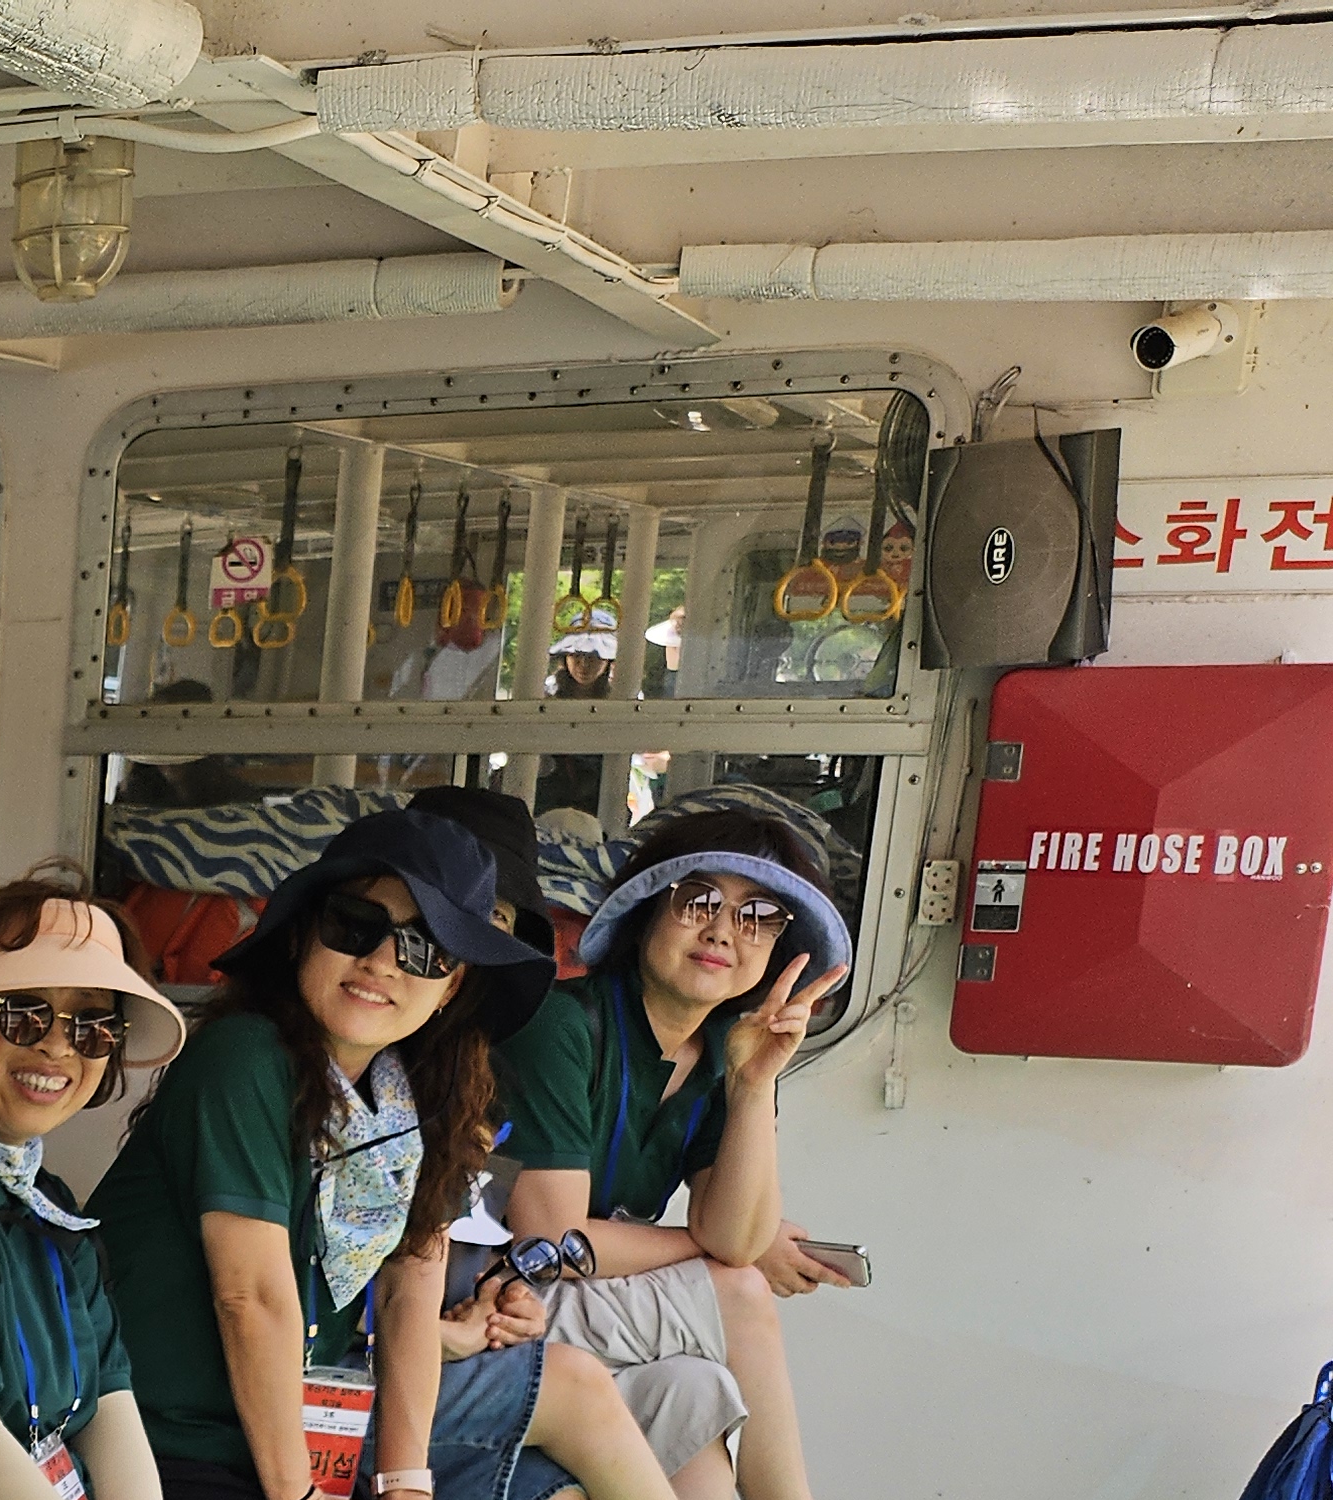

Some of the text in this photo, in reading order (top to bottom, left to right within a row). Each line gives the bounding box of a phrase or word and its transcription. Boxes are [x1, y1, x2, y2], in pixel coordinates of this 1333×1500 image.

[991, 532, 1008, 580] URE
[1028, 830, 1288, 877] FIRE HOSE BOX
